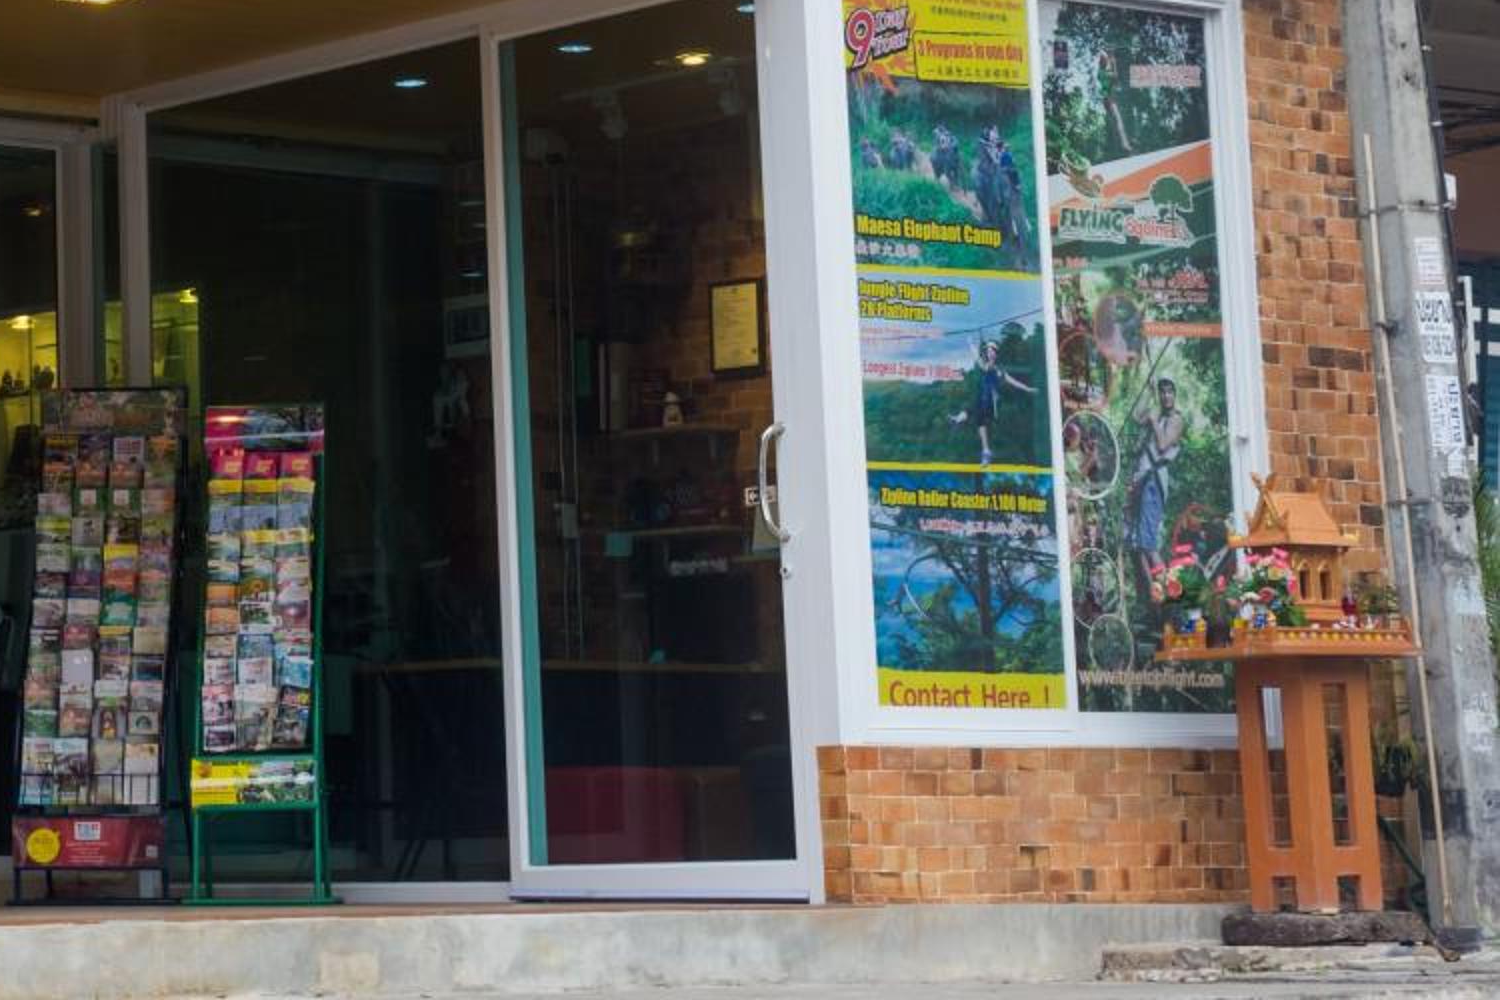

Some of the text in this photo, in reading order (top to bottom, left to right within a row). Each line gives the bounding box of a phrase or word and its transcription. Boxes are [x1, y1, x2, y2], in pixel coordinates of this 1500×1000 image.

[856, 214, 1002, 249] Maesa Elephant Camp
[889, 680, 972, 707] Contact
[982, 683, 1031, 707] Here
